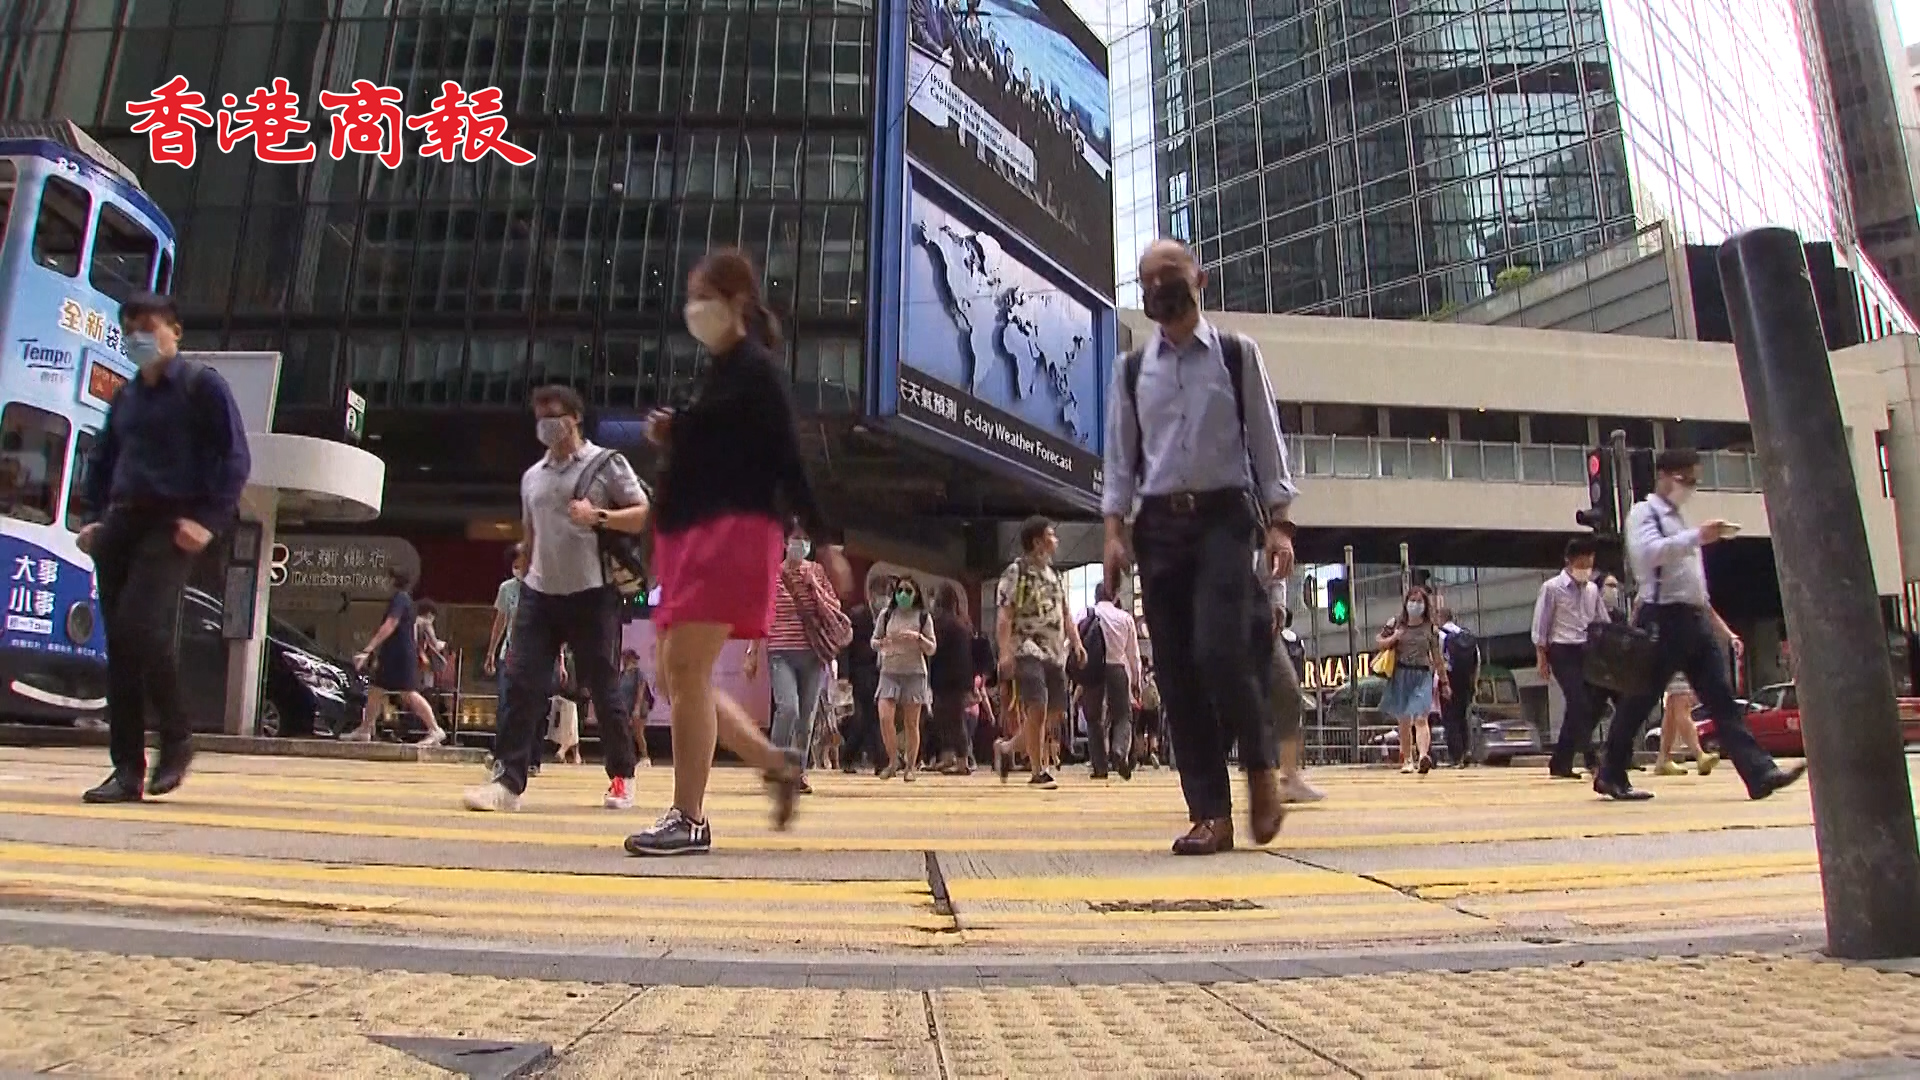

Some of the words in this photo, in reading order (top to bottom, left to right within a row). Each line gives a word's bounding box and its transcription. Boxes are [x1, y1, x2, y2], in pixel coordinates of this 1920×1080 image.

[17, 338, 73, 364] Tempo
[964, 409, 994, 440] 6-day
[994, 423, 1034, 456] Weather
[1036, 440, 1072, 472] Forecast
